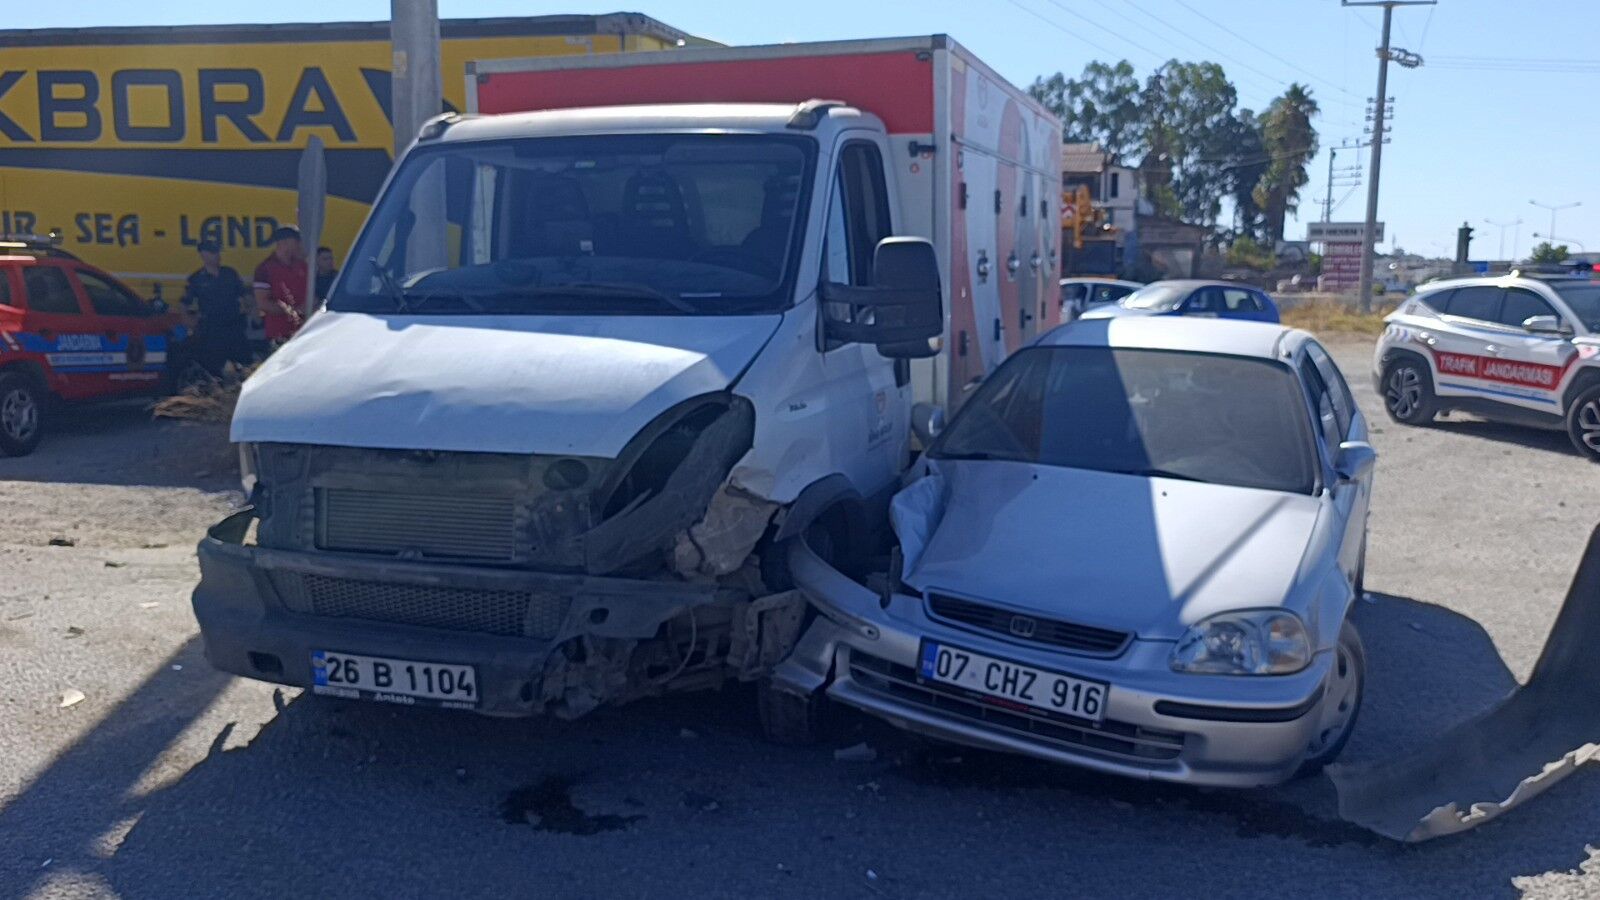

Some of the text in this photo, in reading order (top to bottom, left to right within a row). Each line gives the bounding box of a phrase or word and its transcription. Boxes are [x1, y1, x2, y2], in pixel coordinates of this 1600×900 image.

[75, 211, 139, 248] SEA
[180, 214, 278, 248] LAND
[1483, 360, 1553, 384] JANDARMASI
[327, 656, 473, 697] 26 B 1104
[936, 649, 969, 681] 07
[984, 662, 1037, 701] CHZ
[1051, 679, 1101, 715] 916
